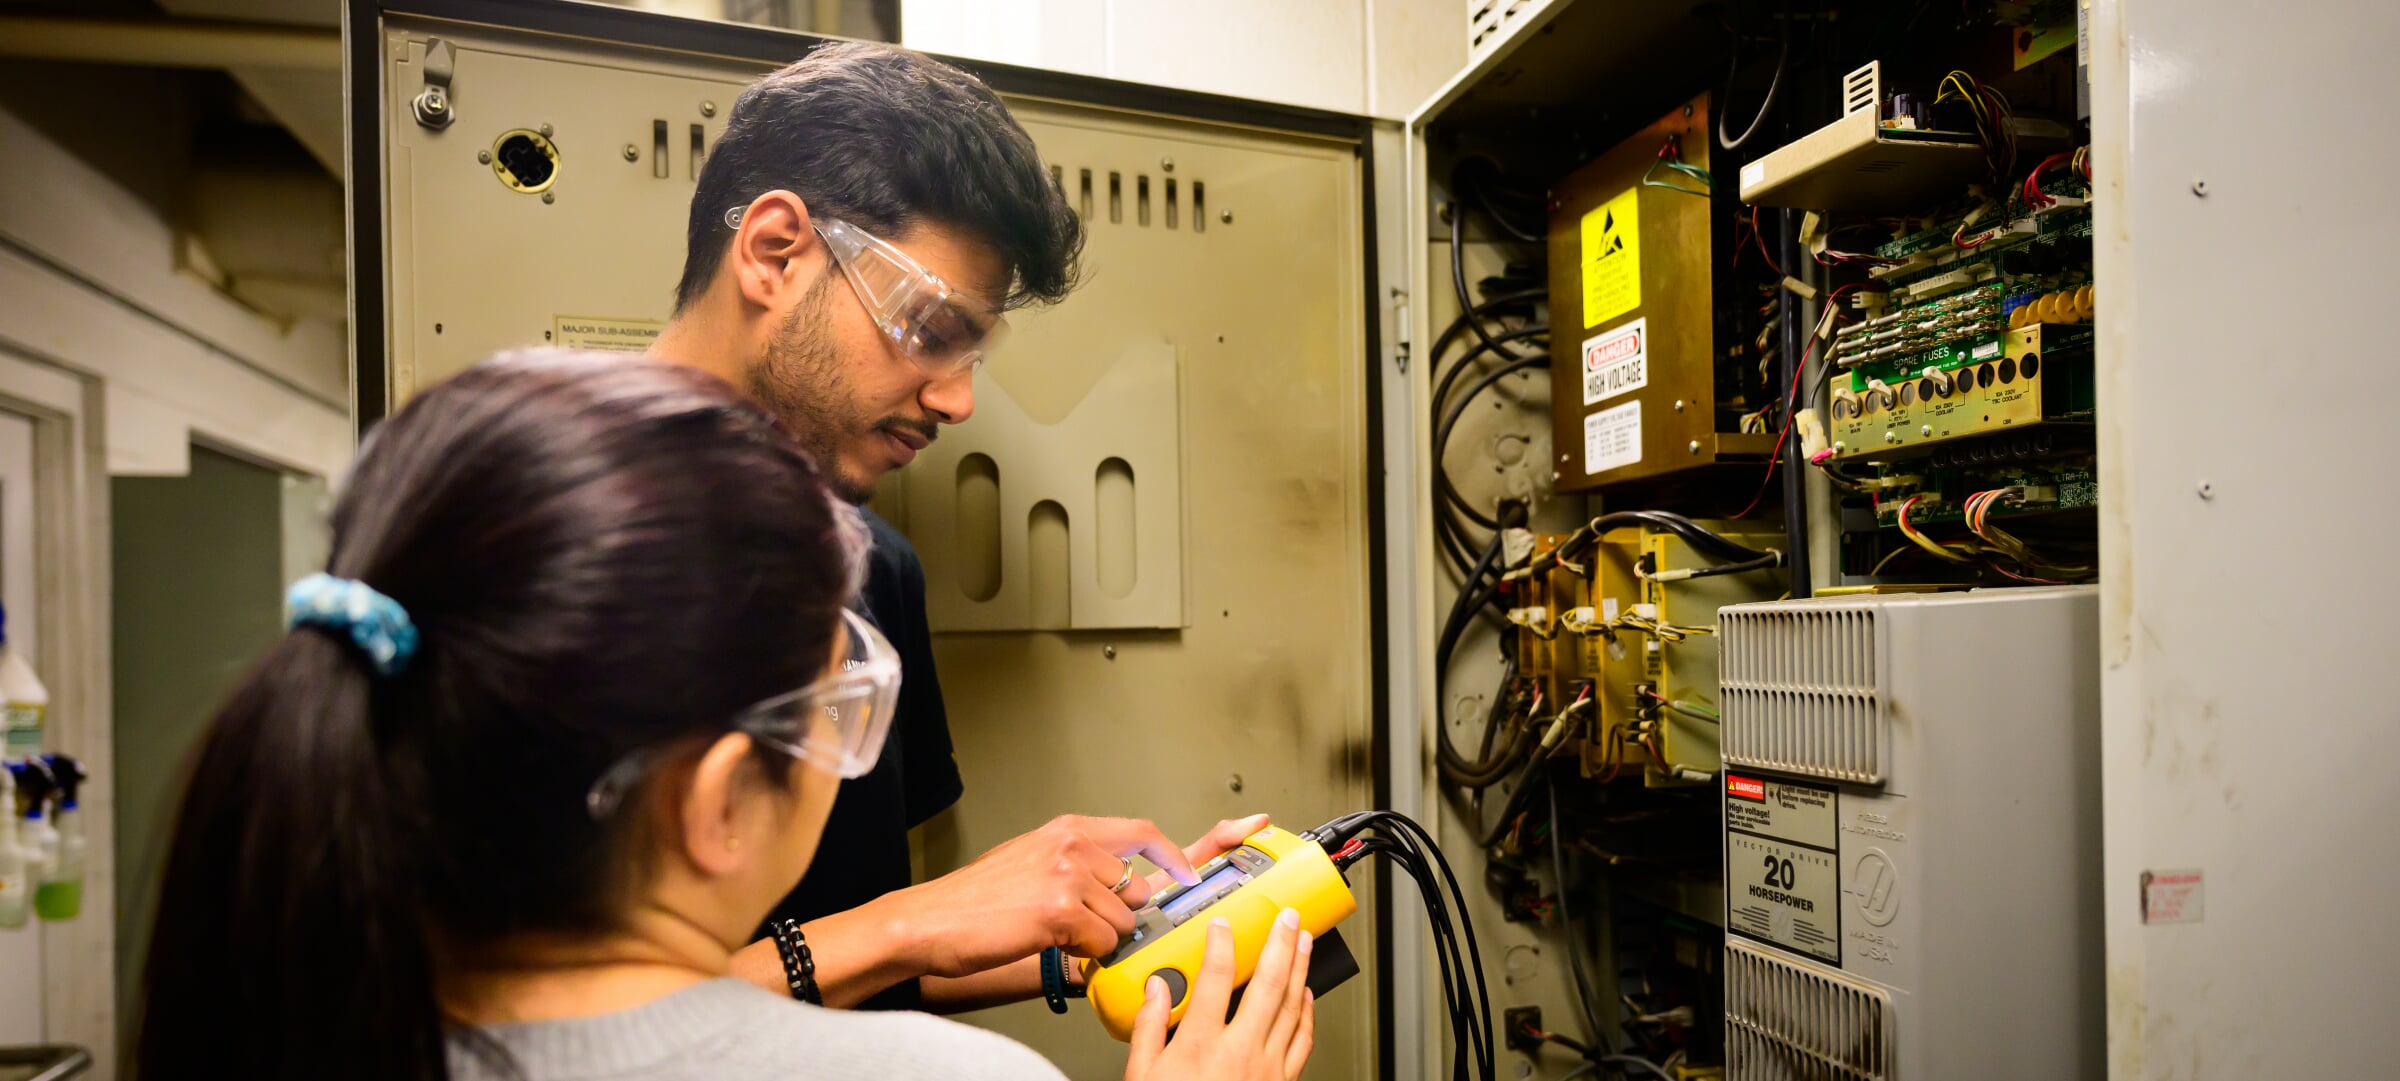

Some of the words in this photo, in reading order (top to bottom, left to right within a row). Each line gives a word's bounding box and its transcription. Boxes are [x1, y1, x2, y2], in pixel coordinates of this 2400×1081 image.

[562, 325, 595, 334] MAJOR
[1593, 336, 1635, 364] DANGER
[1894, 354, 1919, 370] SPARE
[1923, 346, 1950, 363] FUSES
[1588, 372, 1605, 396] HIGH
[1608, 360, 1642, 391] VOLTAGE
[2002, 394, 2022, 403] COOLANT
[1936, 408, 1954, 416] COOLANT
[1736, 782, 1763, 795] DANGER!
[1782, 793, 1799, 802] before
[1800, 797, 1826, 808] replacing
[1782, 801, 1797, 809] drive.
[1729, 802, 1744, 814] High
[1745, 807, 1770, 819] voltage!
[1857, 812, 1888, 825] Haas
[1746, 816, 1771, 826] serviceable
[1841, 824, 1907, 843] Automation
[1736, 840, 1781, 856] VECTOR
[1790, 852, 1830, 867] DRIVE
[1763, 855, 1796, 891] 20
[1749, 884, 1815, 913] HORSEPOWER
[1850, 930, 1884, 945] MADE
[1887, 936, 1900, 950] IN
[1858, 947, 1894, 965] USA
